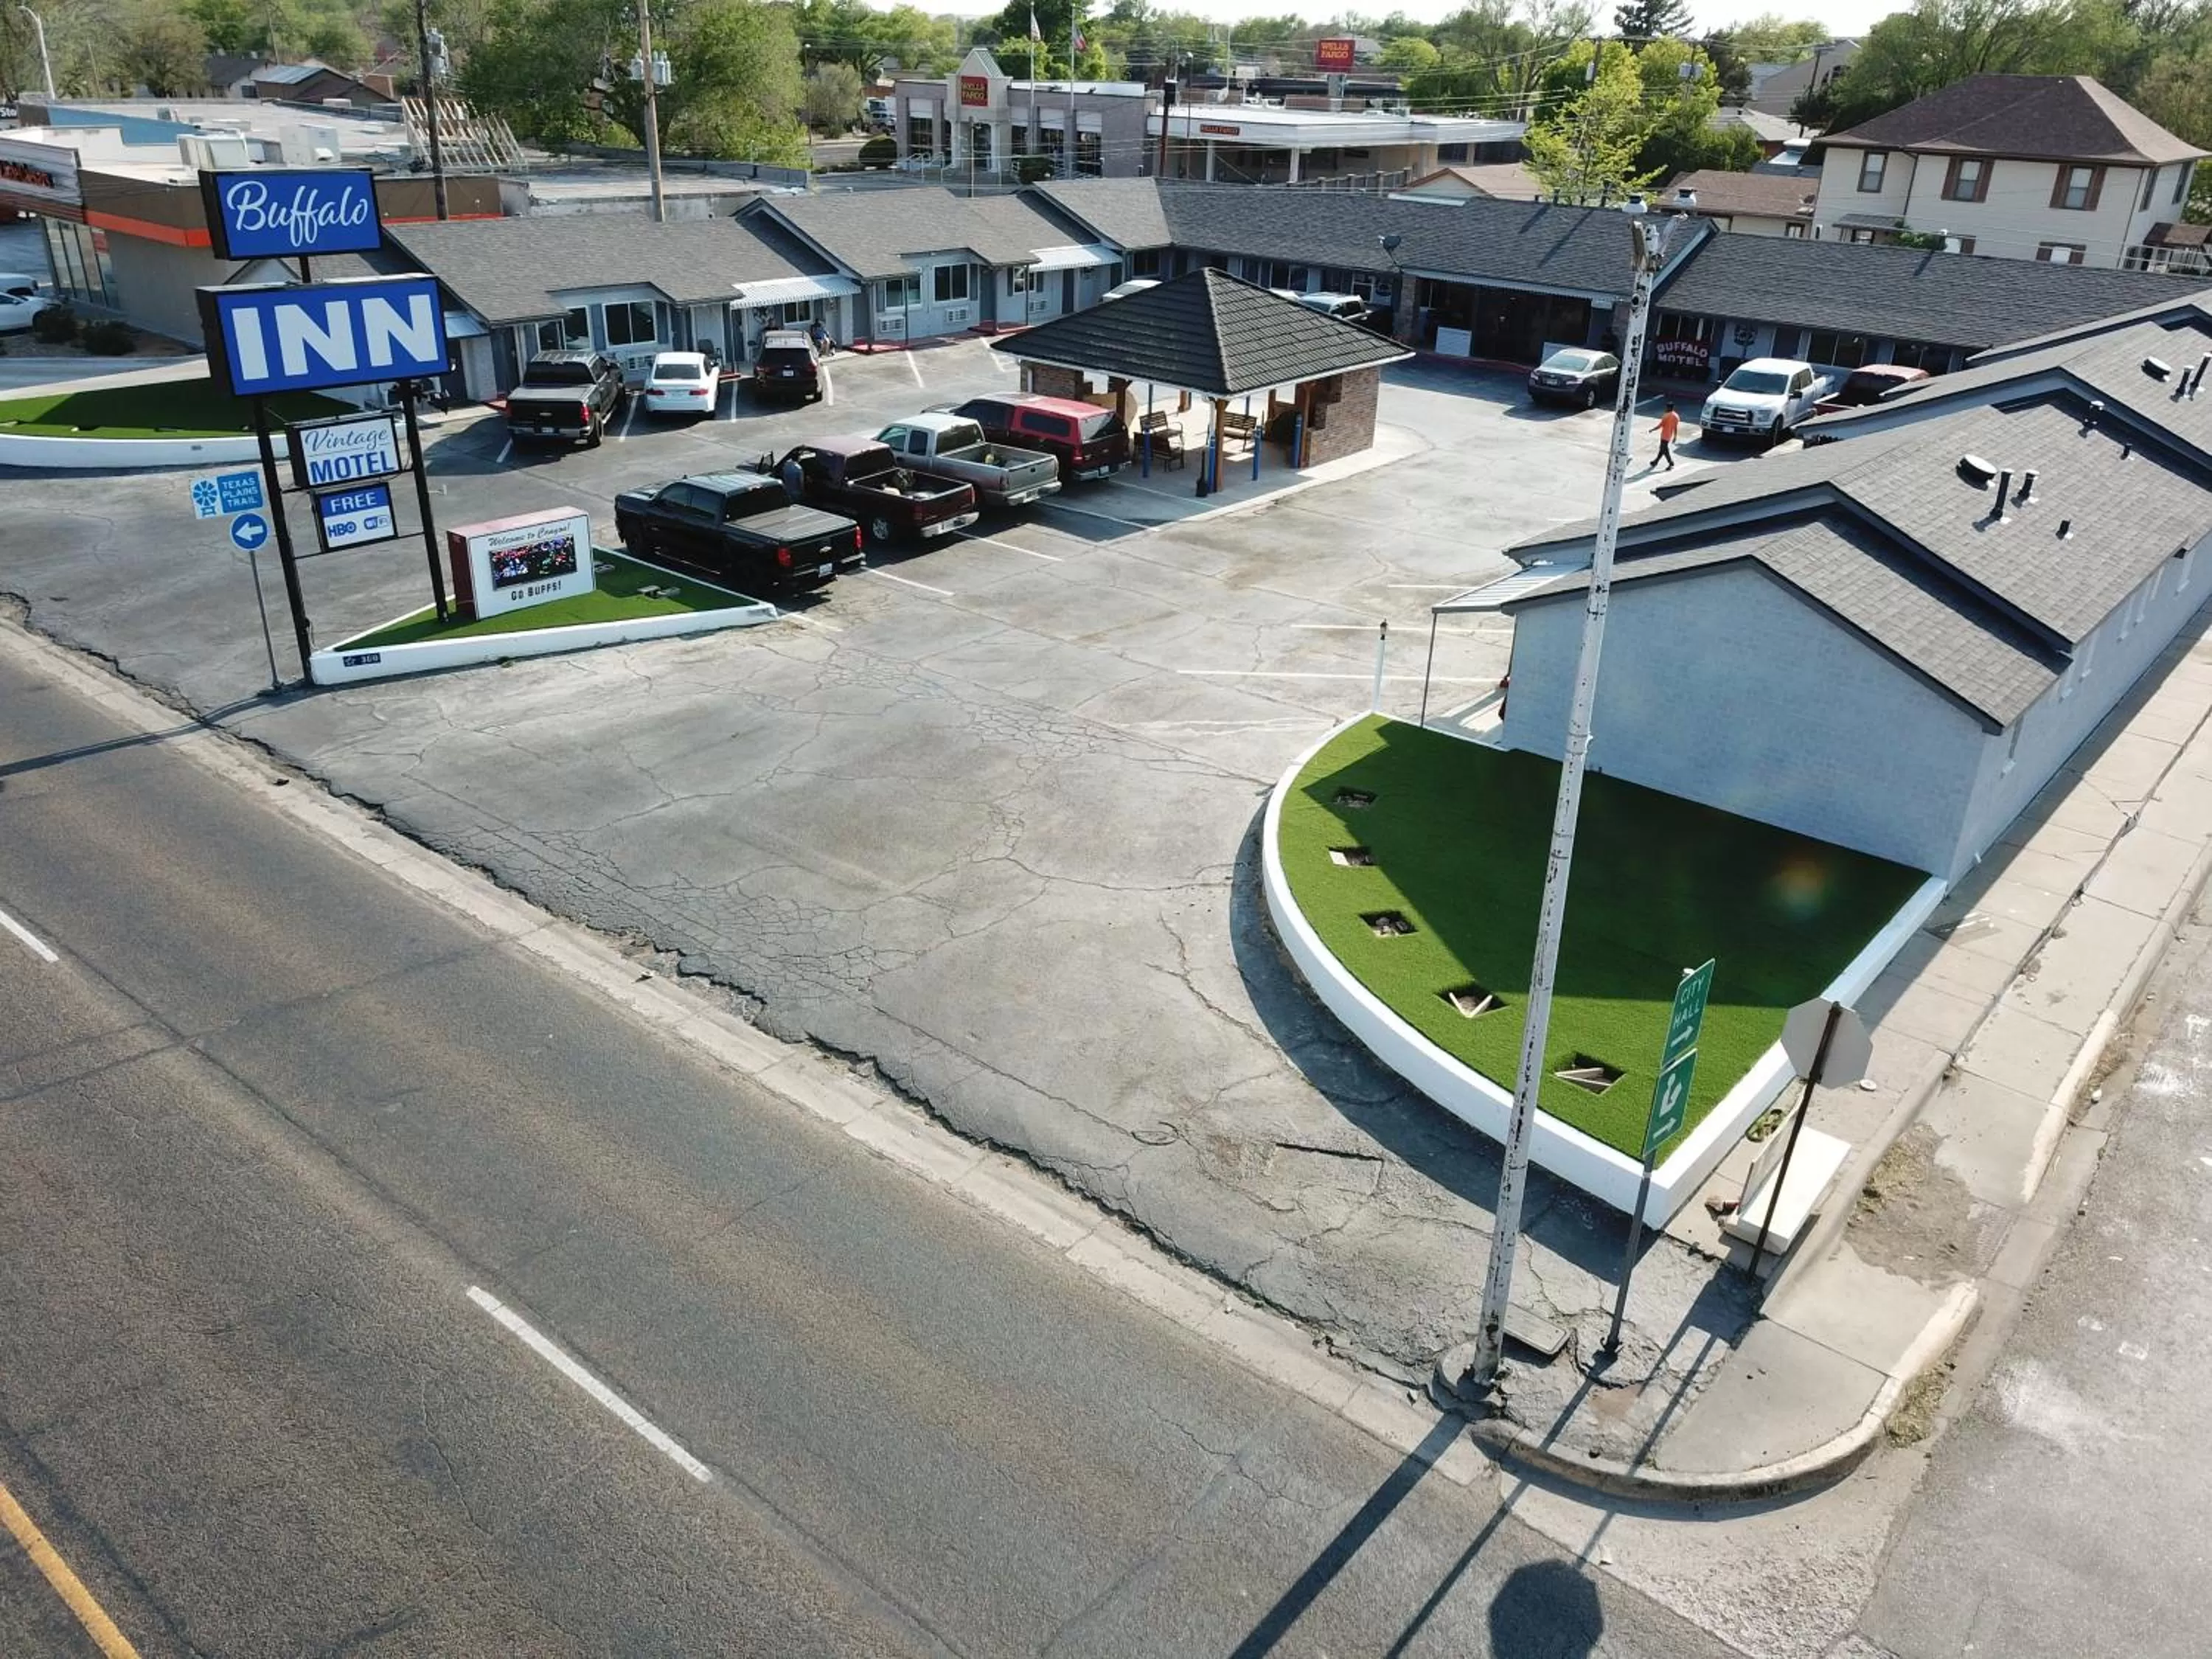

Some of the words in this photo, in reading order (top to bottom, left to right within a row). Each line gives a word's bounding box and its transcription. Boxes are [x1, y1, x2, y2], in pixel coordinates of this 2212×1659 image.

[226, 181, 369, 247] Buffalo
[231, 294, 439, 380] INN
[1657, 341, 1708, 358] BUFFALO
[1658, 353, 1703, 366] MOTEL
[305, 428, 388, 453] Vintage
[309, 451, 394, 484] MOTEL
[222, 478, 256, 490] TEXAS
[222, 487, 258, 500] PLAINS
[227, 495, 258, 508] TRAIL
[330, 492, 378, 513] FREE
[327, 521, 357, 538] HBO
[487, 535, 526, 546] Welcome
[526, 532, 535, 540] to
[527, 580, 561, 597] BUFFS!
[1680, 973, 1706, 1005] CITY
[1672, 998, 1700, 1030] HALL
